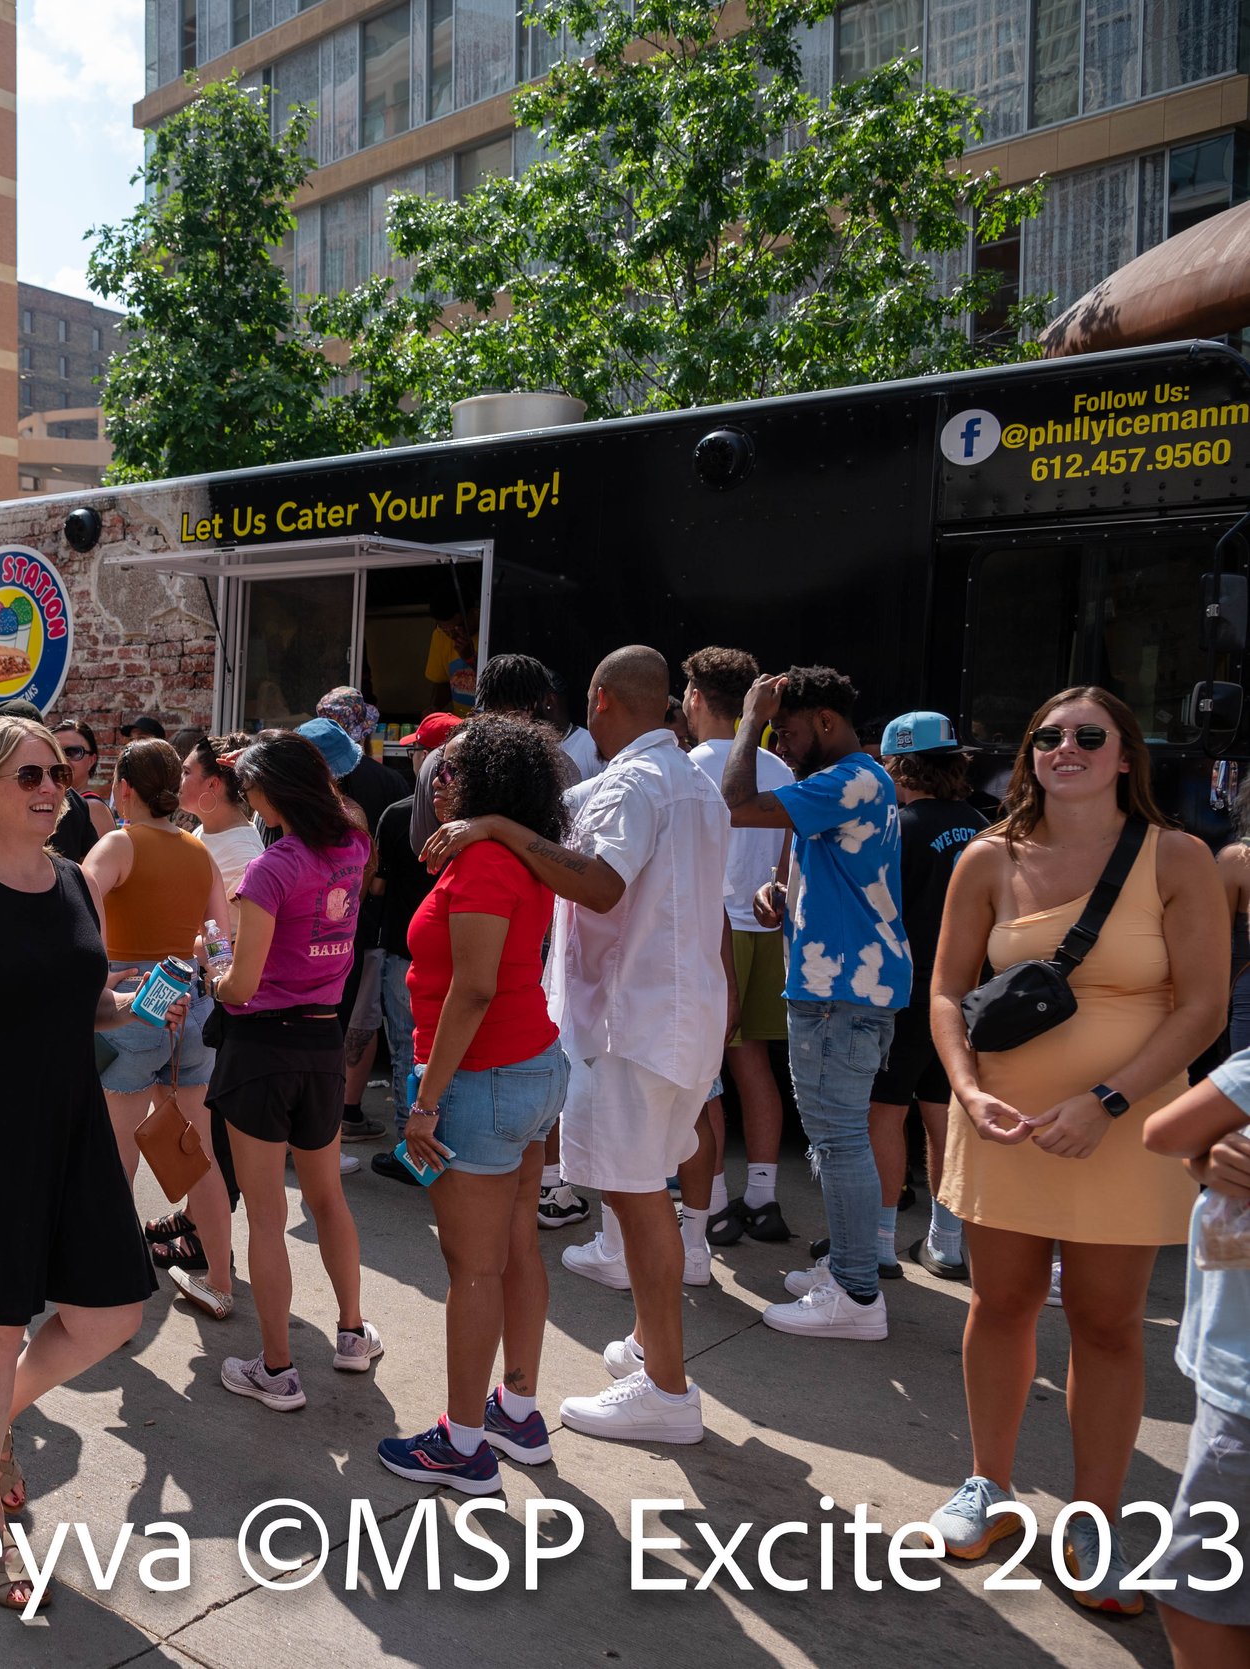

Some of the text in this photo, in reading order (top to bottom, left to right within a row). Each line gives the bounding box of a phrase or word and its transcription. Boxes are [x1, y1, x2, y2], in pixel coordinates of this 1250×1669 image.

[1073, 383, 1190, 414] Follow Us:
[1031, 438, 1231, 482] 612.457.9560
[180, 471, 560, 543] Let Us Cater Your Party!
[1, 555, 68, 641] STATION
[930, 827, 977, 853] WE GOT
[149, 979, 178, 1001] TASTE
[142, 997, 172, 1017] OF MN
